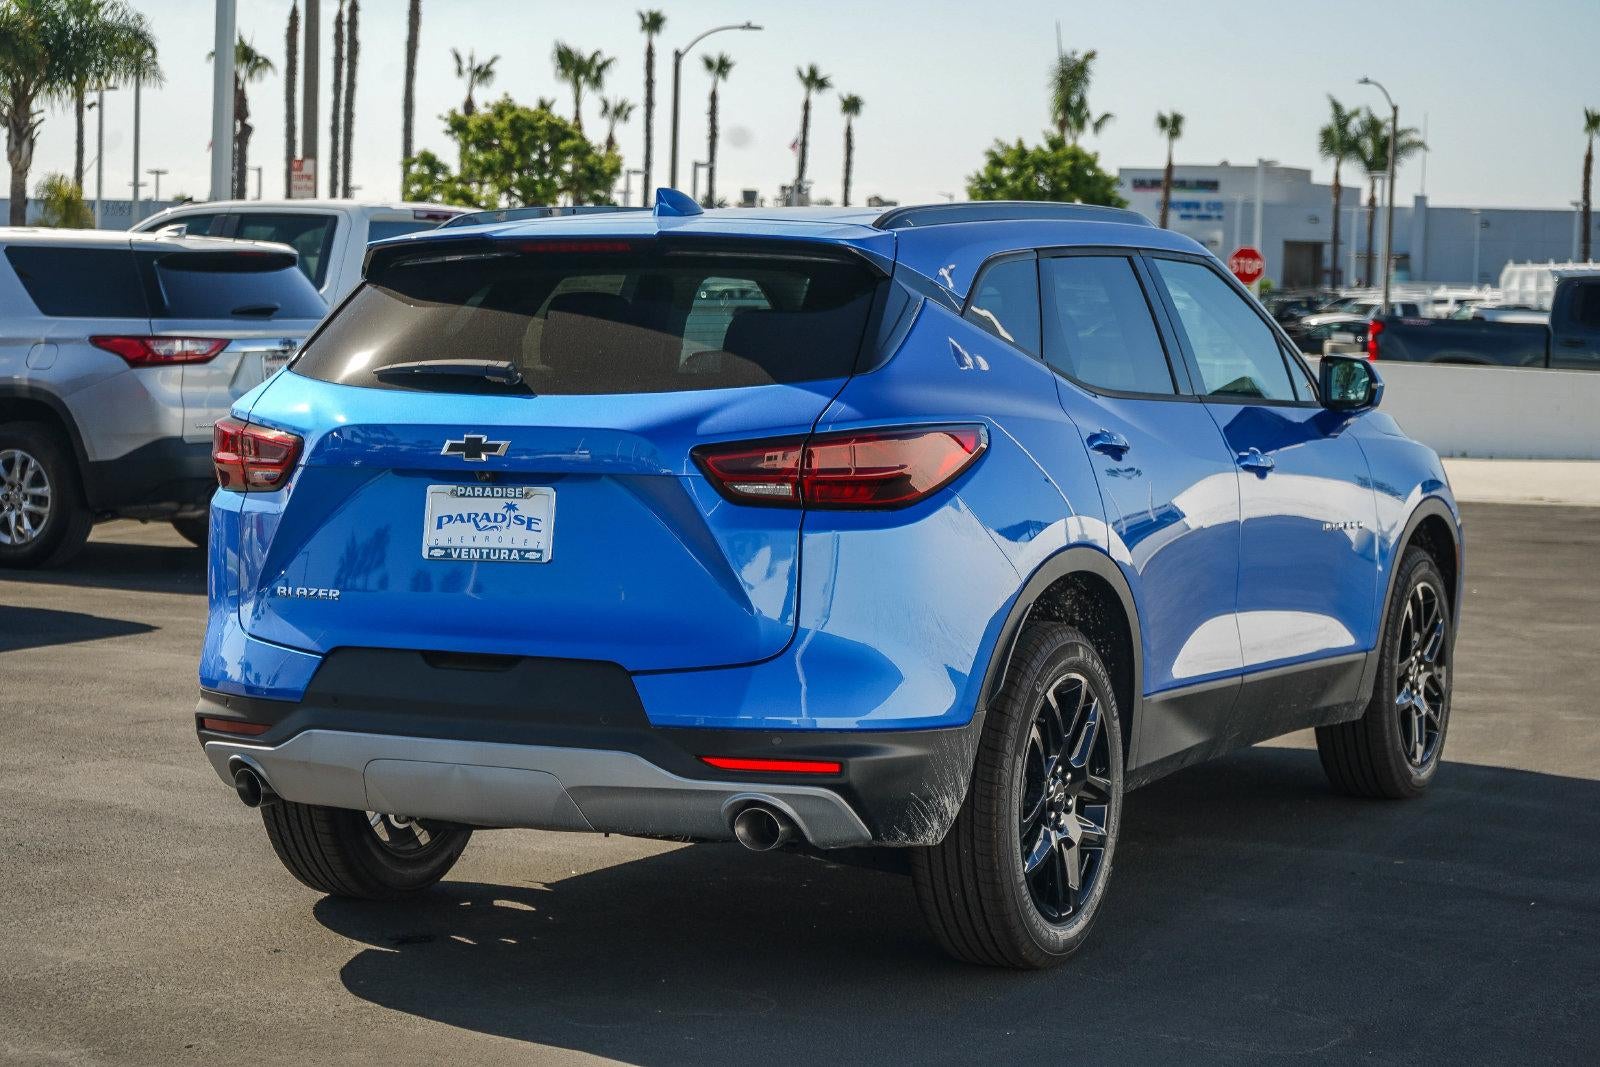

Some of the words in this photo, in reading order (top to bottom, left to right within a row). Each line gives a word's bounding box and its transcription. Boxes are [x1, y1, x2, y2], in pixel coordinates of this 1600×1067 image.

[1230, 256, 1264, 275] STOP
[456, 486, 524, 498] PARADISE
[436, 506, 543, 533] PARADISE
[433, 535, 541, 549] CHEVROLET
[450, 547, 520, 560] VENTURA
[276, 585, 340, 601] BLAZER
